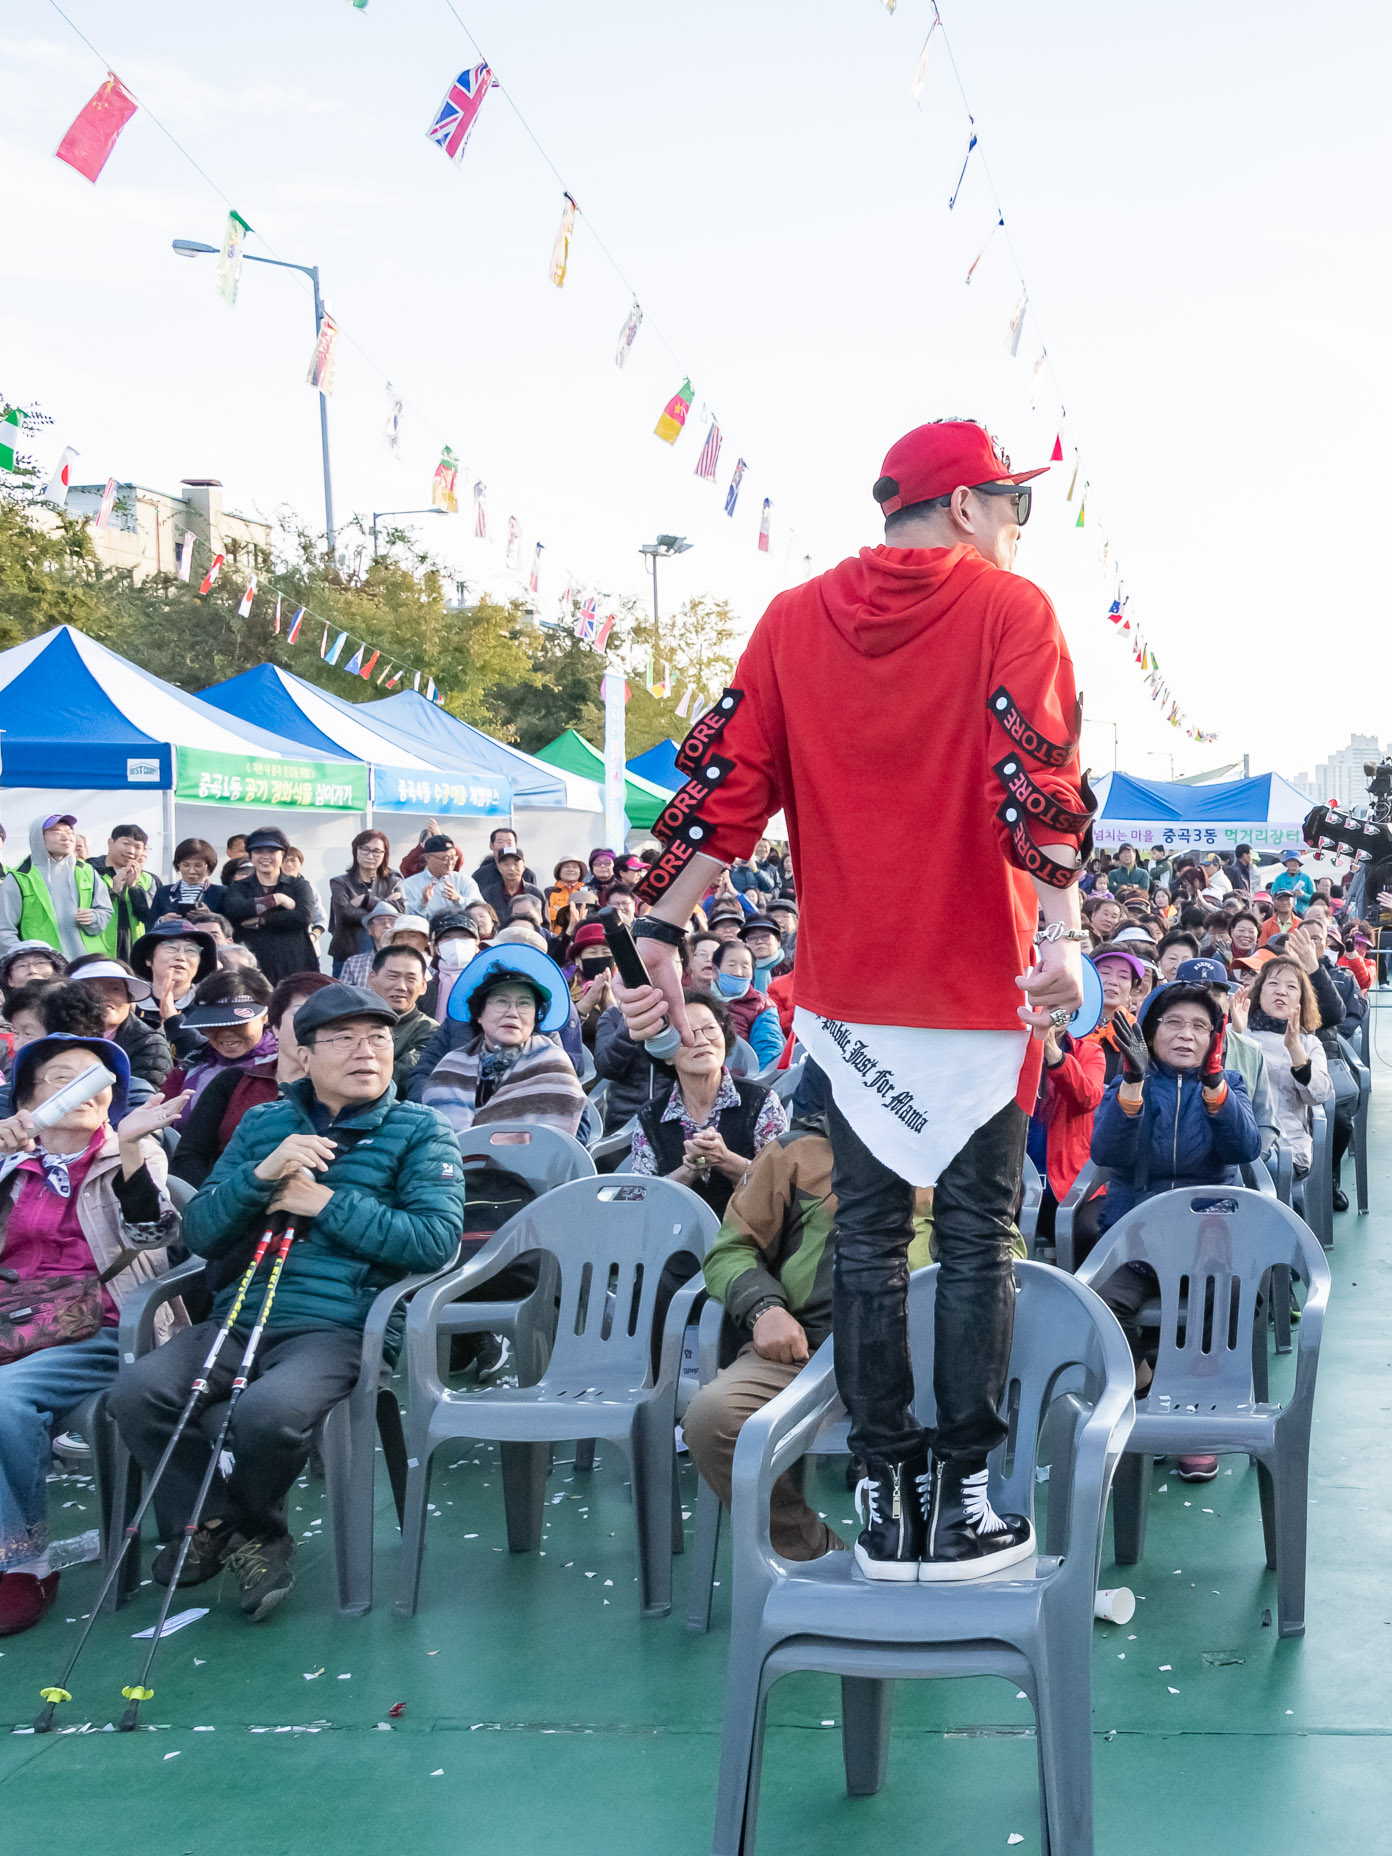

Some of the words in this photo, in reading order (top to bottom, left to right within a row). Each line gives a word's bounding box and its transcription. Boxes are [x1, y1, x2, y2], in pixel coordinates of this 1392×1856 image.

[244, 777, 269, 803] 공기
[1093, 829, 1128, 842] 넘치는
[1131, 829, 1154, 843] 마을
[1162, 828, 1218, 845] 중곡3동
[1224, 828, 1300, 845] 먹거리장터
[841, 1039, 879, 1078] Just
[862, 1069, 895, 1099] For
[880, 1091, 929, 1134] Mania
